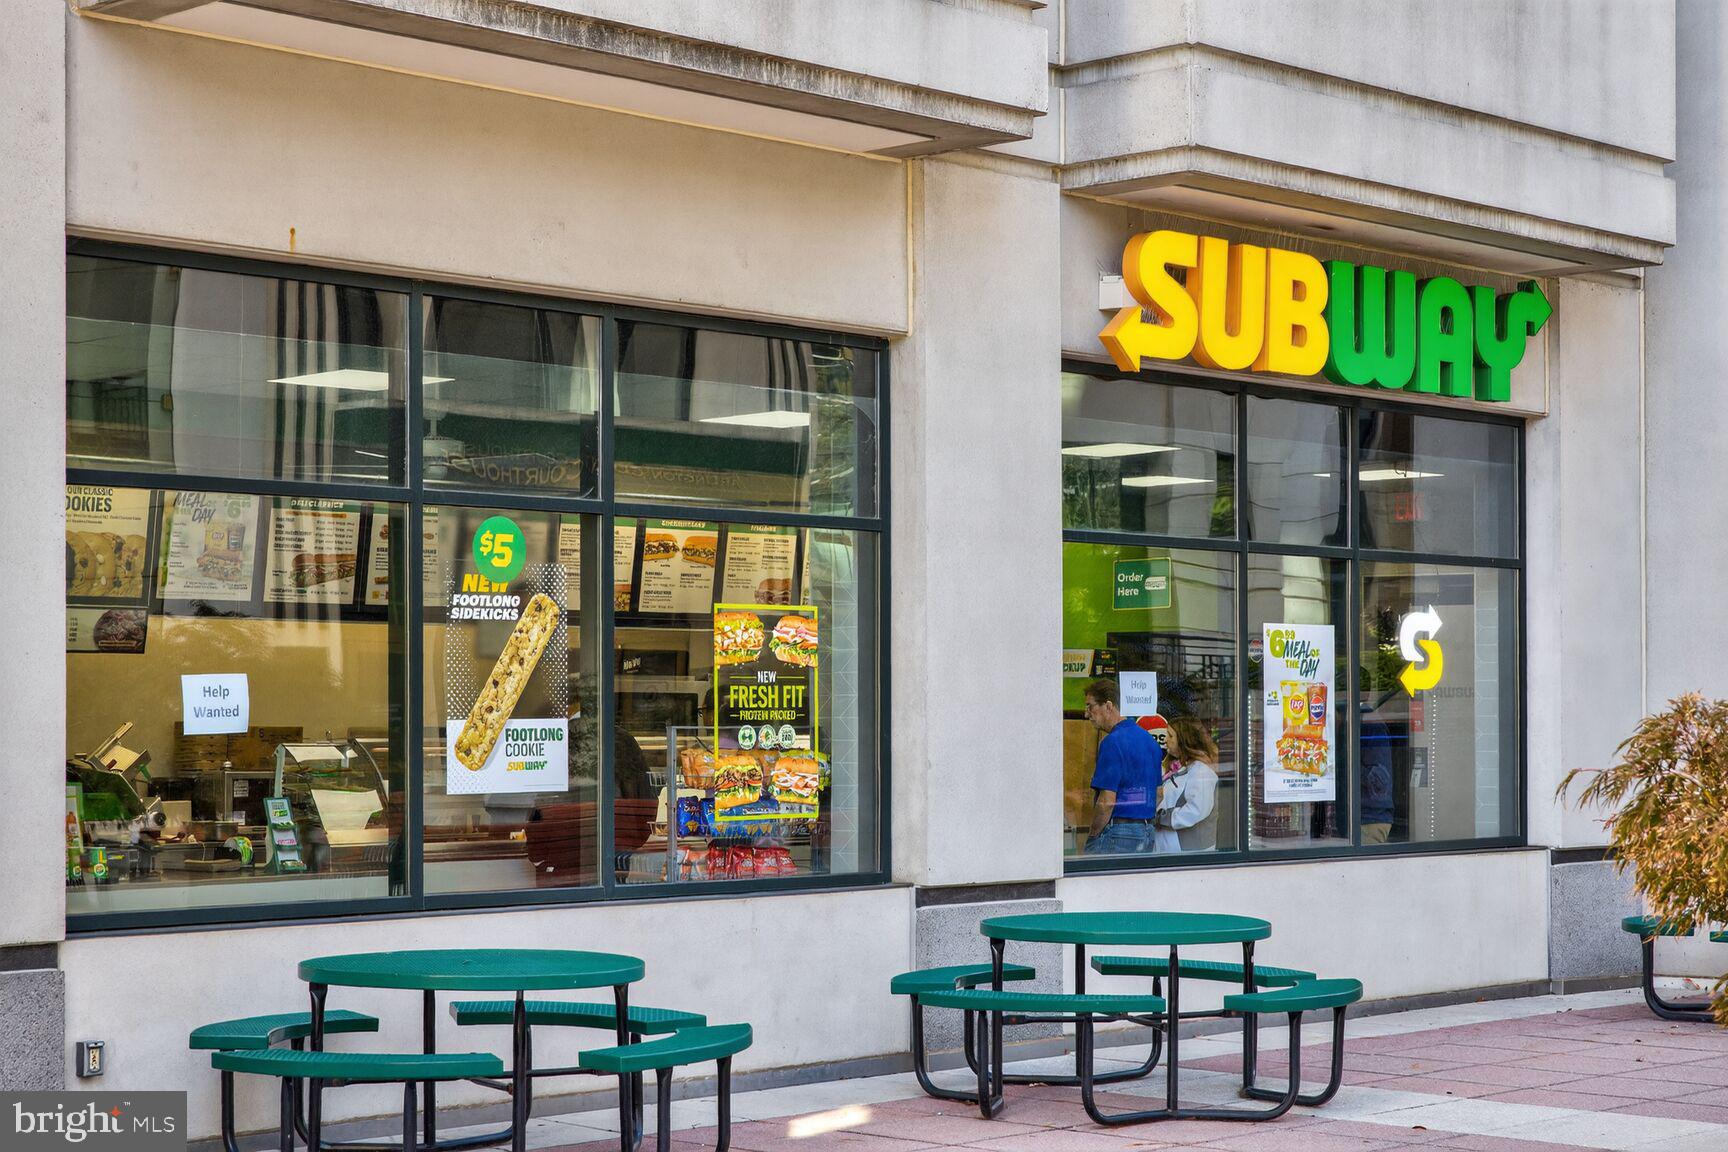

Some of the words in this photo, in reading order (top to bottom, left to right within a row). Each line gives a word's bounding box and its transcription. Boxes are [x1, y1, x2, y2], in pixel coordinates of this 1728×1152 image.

[1099, 230, 1553, 402] SUBWAY
[480, 530, 514, 567] $5
[1117, 573, 1143, 582] Order
[1117, 587, 1139, 596] Here
[452, 594, 520, 607] FOOTLONG
[450, 607, 519, 620] SIDEKICKS
[1283, 640, 1311, 659] MEAL
[757, 671, 776, 682] NEW
[1300, 659, 1320, 680] DAY
[203, 685, 230, 700] Help
[729, 685, 778, 708] FRESH
[783, 685, 805, 708] FIT
[193, 704, 239, 718] Wanted
[505, 727, 564, 742] FOOTLONG
[505, 743, 545, 757] COOKIE
[507, 761, 546, 771] SUBWAY
